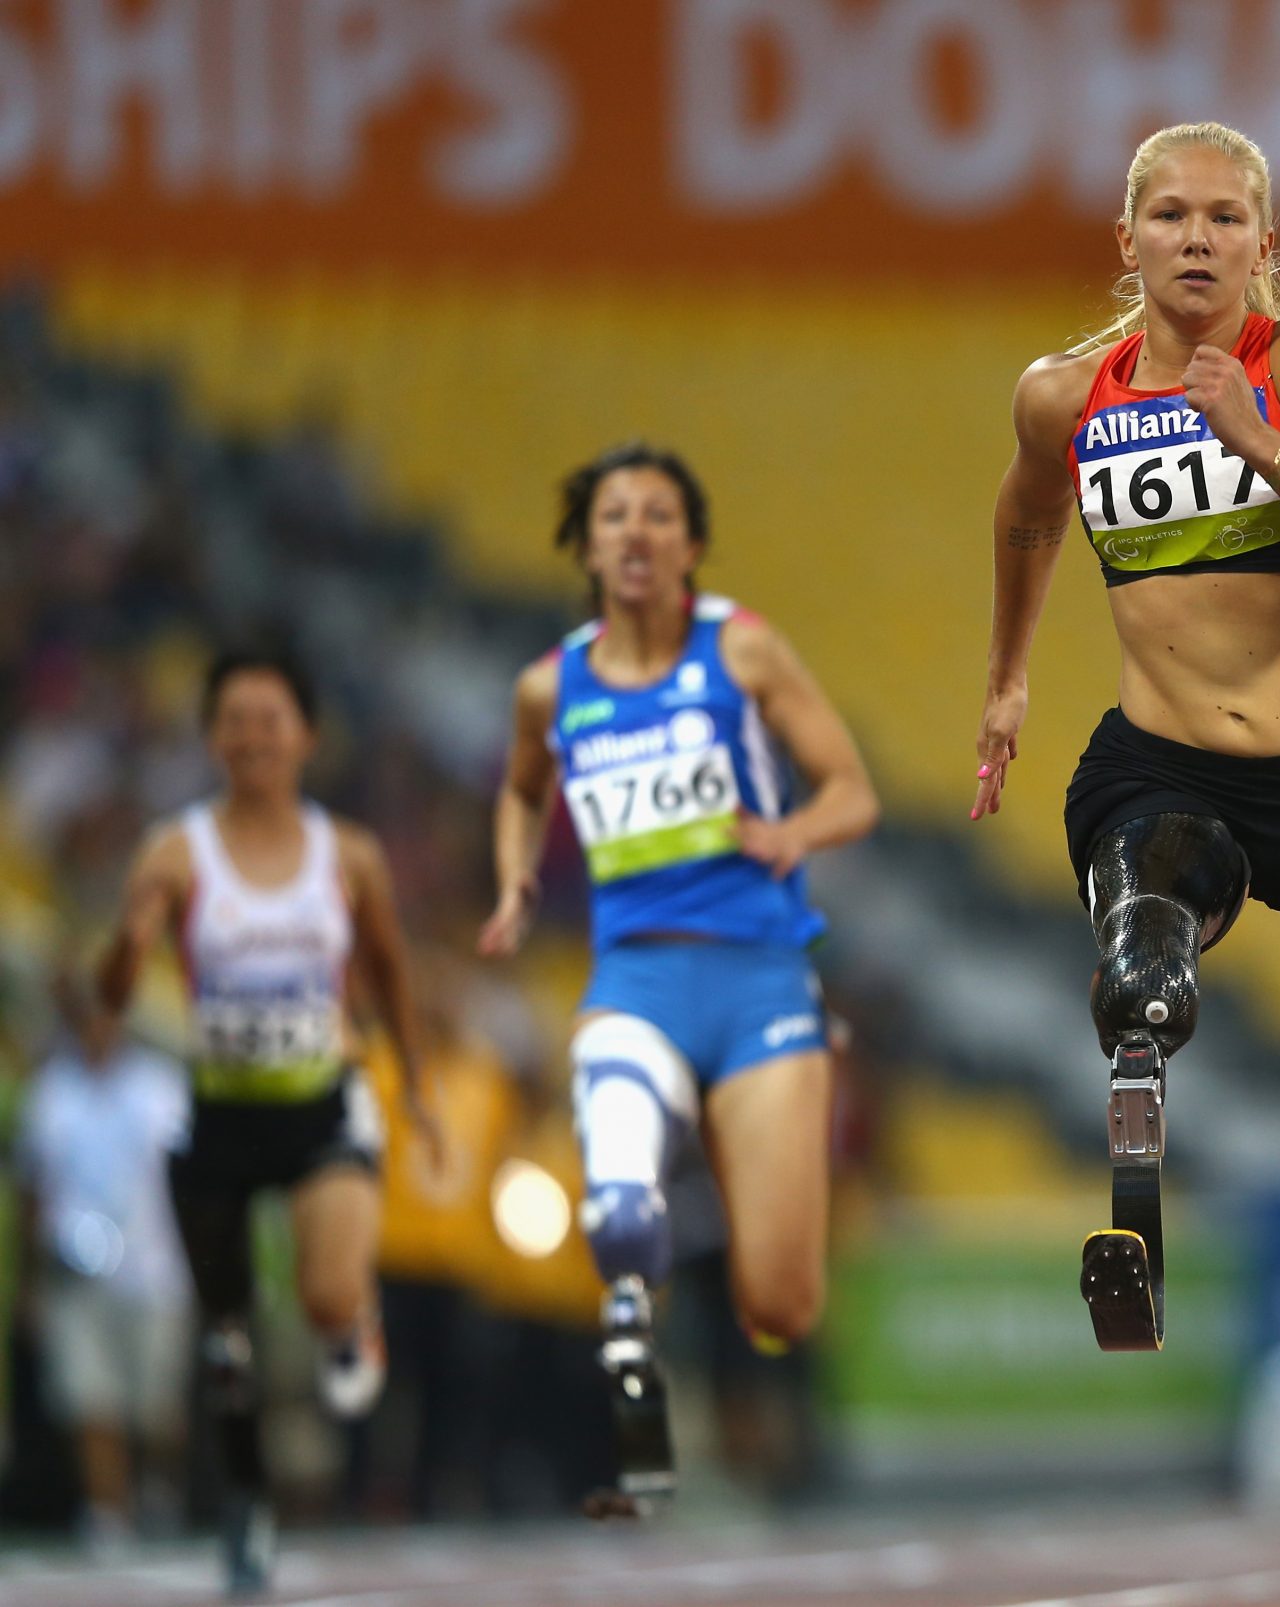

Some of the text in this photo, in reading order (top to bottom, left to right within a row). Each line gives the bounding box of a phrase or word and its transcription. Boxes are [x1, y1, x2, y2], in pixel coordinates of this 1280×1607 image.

[1085, 408, 1202, 450] Allianz
[1089, 446, 1256, 526] 1617
[1135, 529, 1183, 543] ATHLETICS
[583, 760, 725, 836] 1766
